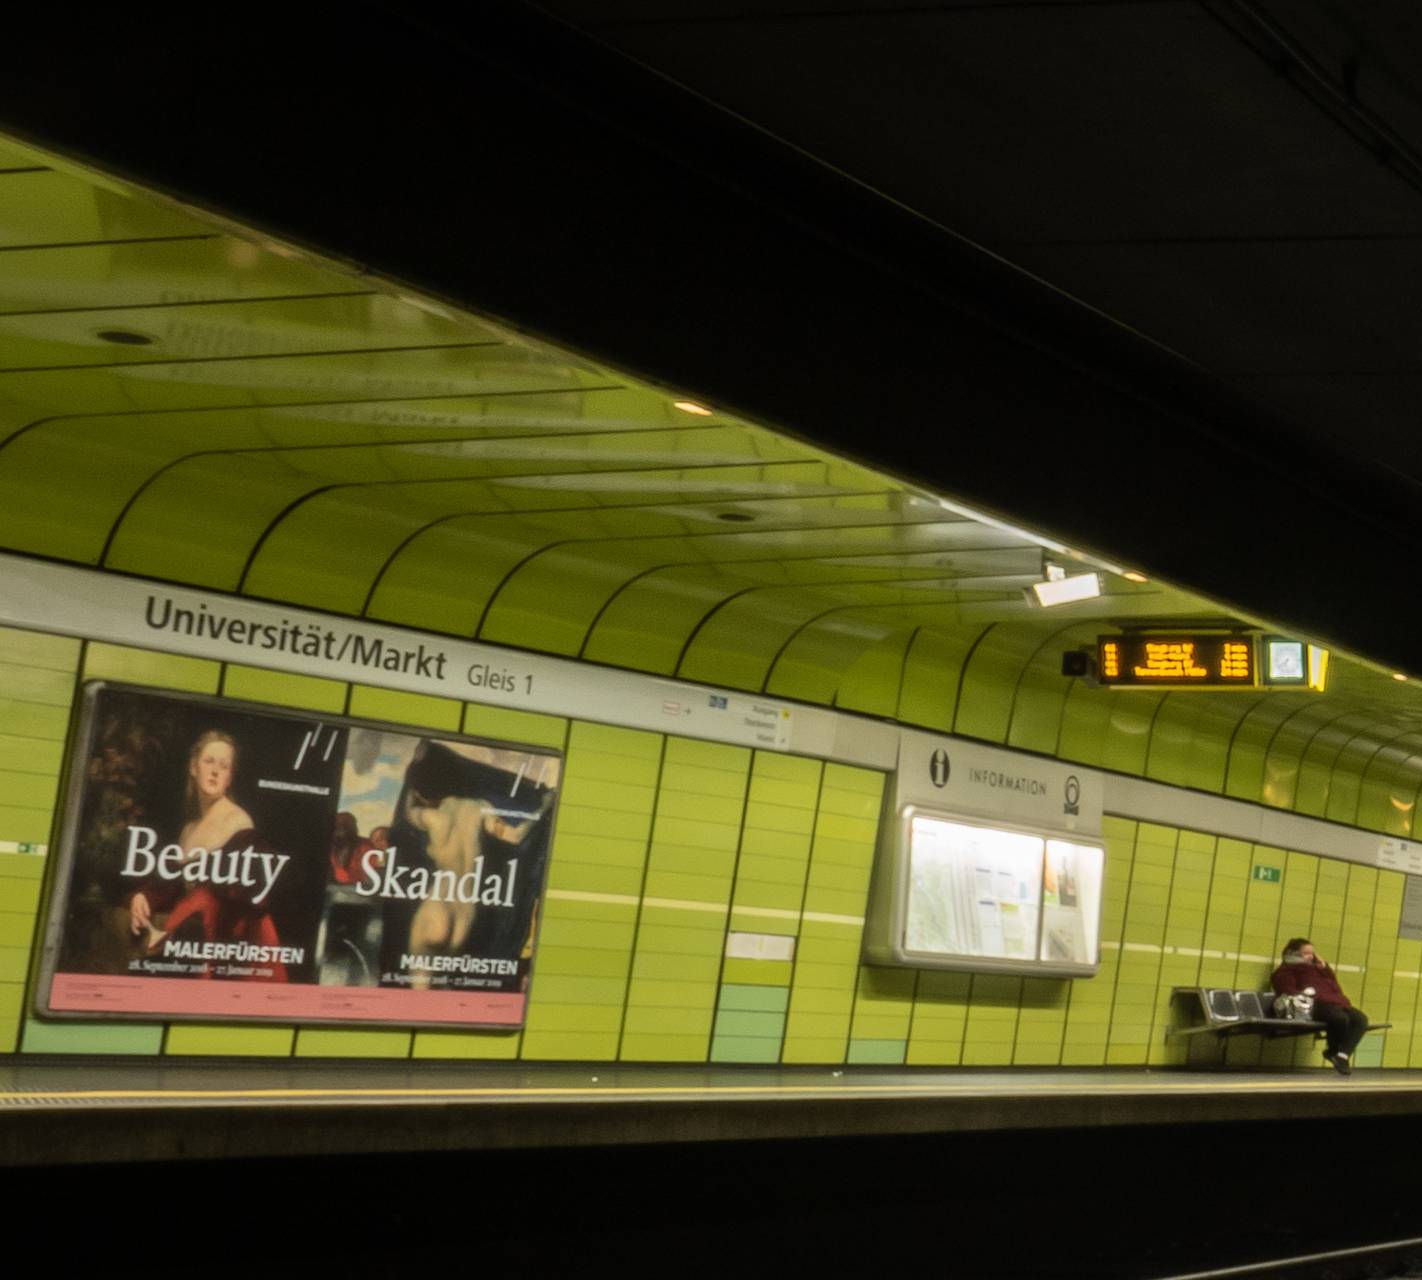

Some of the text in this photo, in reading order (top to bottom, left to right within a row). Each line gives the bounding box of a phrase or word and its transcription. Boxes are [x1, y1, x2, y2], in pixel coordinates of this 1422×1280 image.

[145, 596, 534, 695] Universität/Markt Gleis 1
[969, 768, 1047, 796] INFORMATION
[120, 825, 291, 904] Beauty
[356, 846, 519, 907] Skandal
[163, 941, 304, 964] MALERFÜRSTEN
[400, 954, 518, 975] MALERFÜRSTEN
